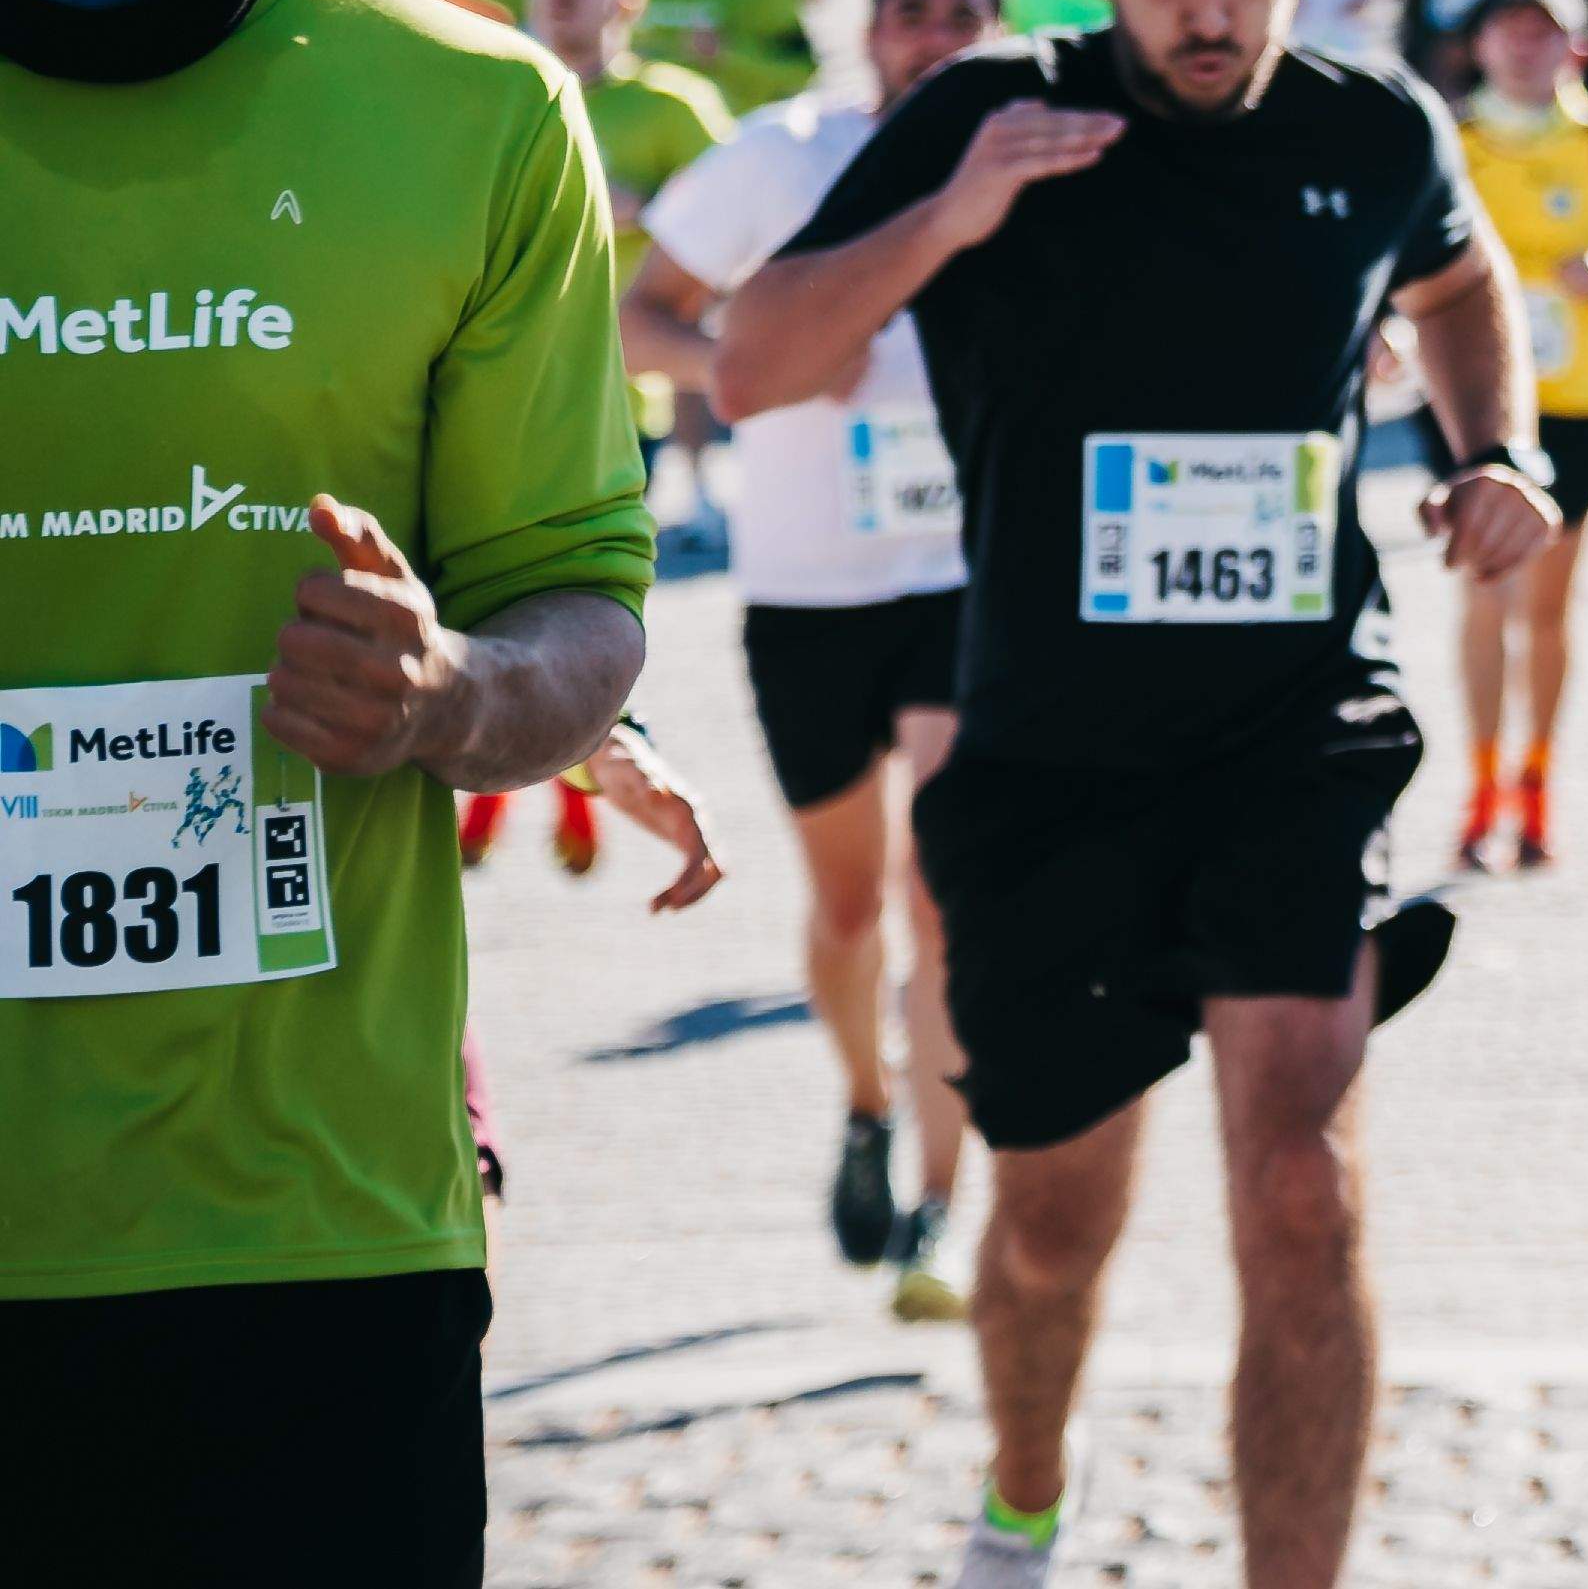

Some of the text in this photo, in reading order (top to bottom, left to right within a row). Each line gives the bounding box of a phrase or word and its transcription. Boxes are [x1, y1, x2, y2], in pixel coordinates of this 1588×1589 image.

[0, 289, 294, 355] MetLife
[1150, 547, 1276, 603] 1463
[70, 719, 237, 763] MetLife
[0, 795, 38, 819] VIII
[12, 862, 222, 968] 1831
